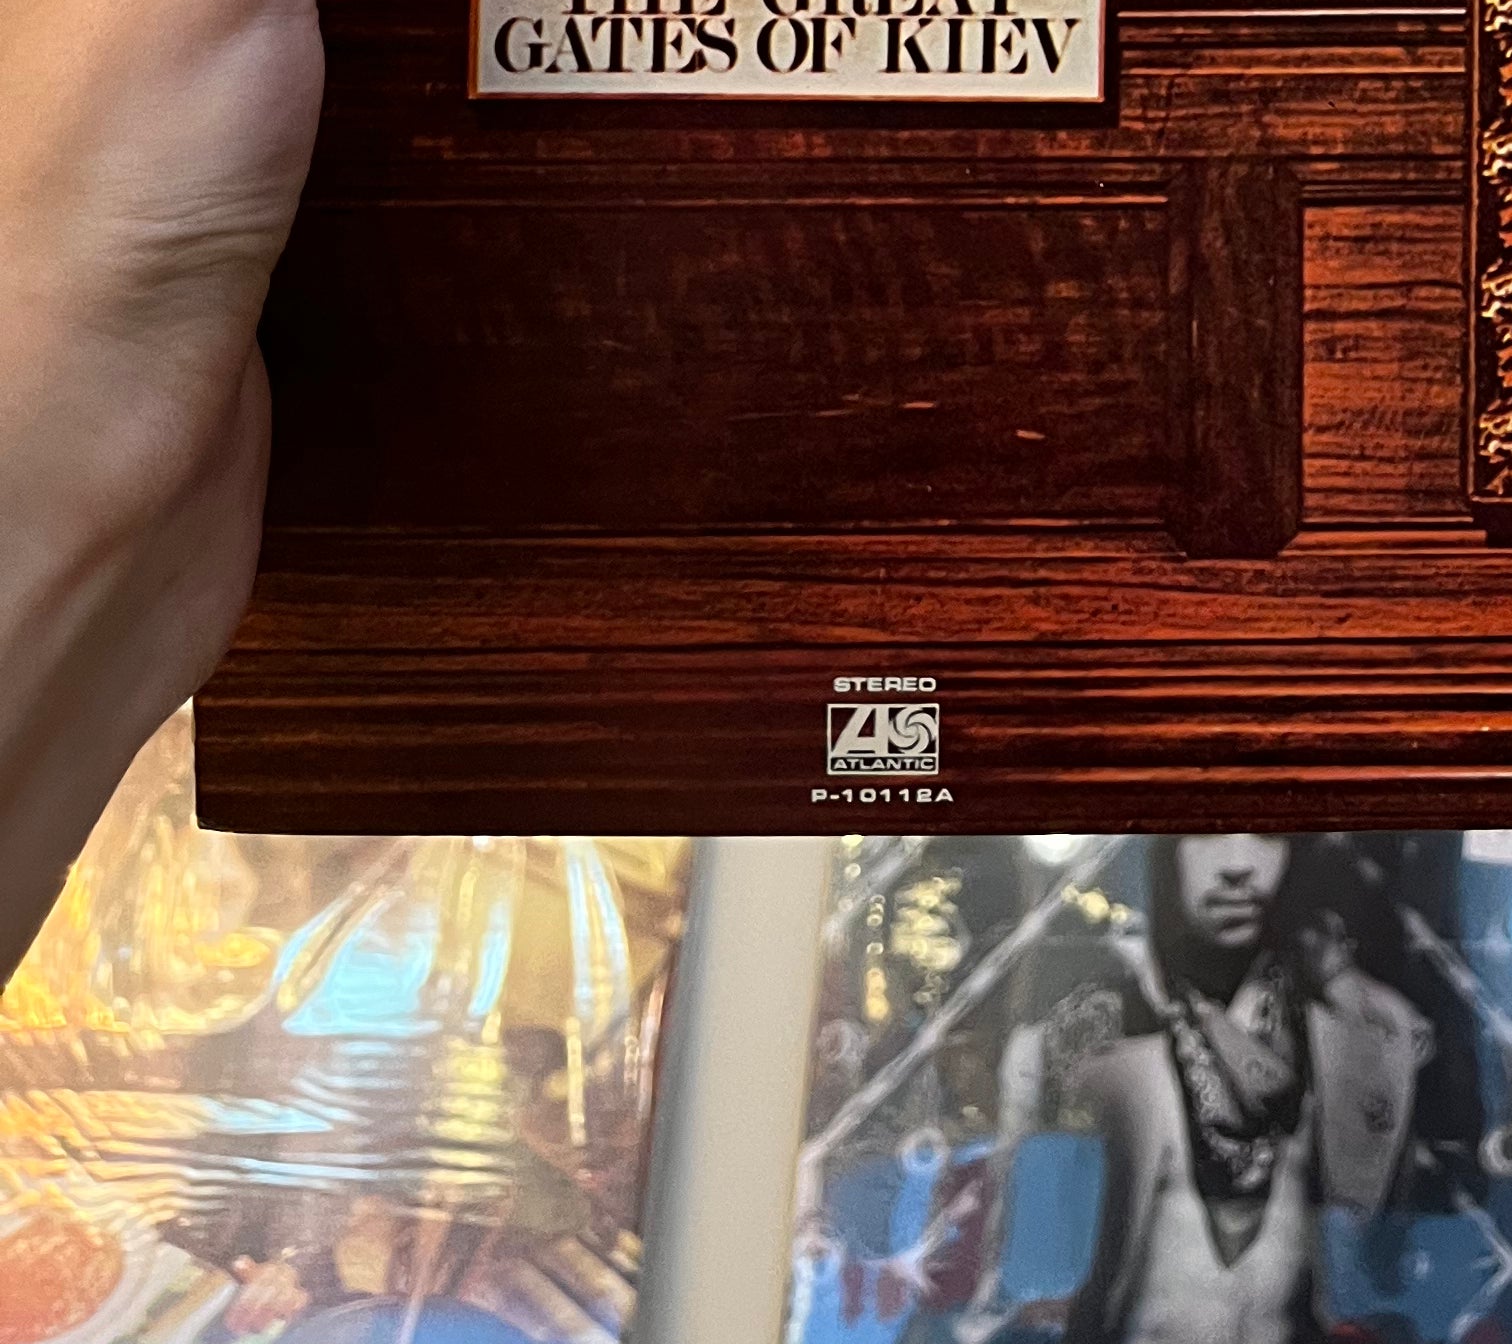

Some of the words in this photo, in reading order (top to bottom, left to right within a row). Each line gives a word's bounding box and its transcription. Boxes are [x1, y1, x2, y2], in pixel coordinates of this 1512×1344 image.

[494, 16, 740, 74] GATES
[756, 17, 858, 74] OF
[884, 17, 1083, 74] KIEV
[832, 677, 938, 693] STEREO
[832, 758, 935, 770] ATLANTIC
[810, 788, 954, 803] P-10112A
